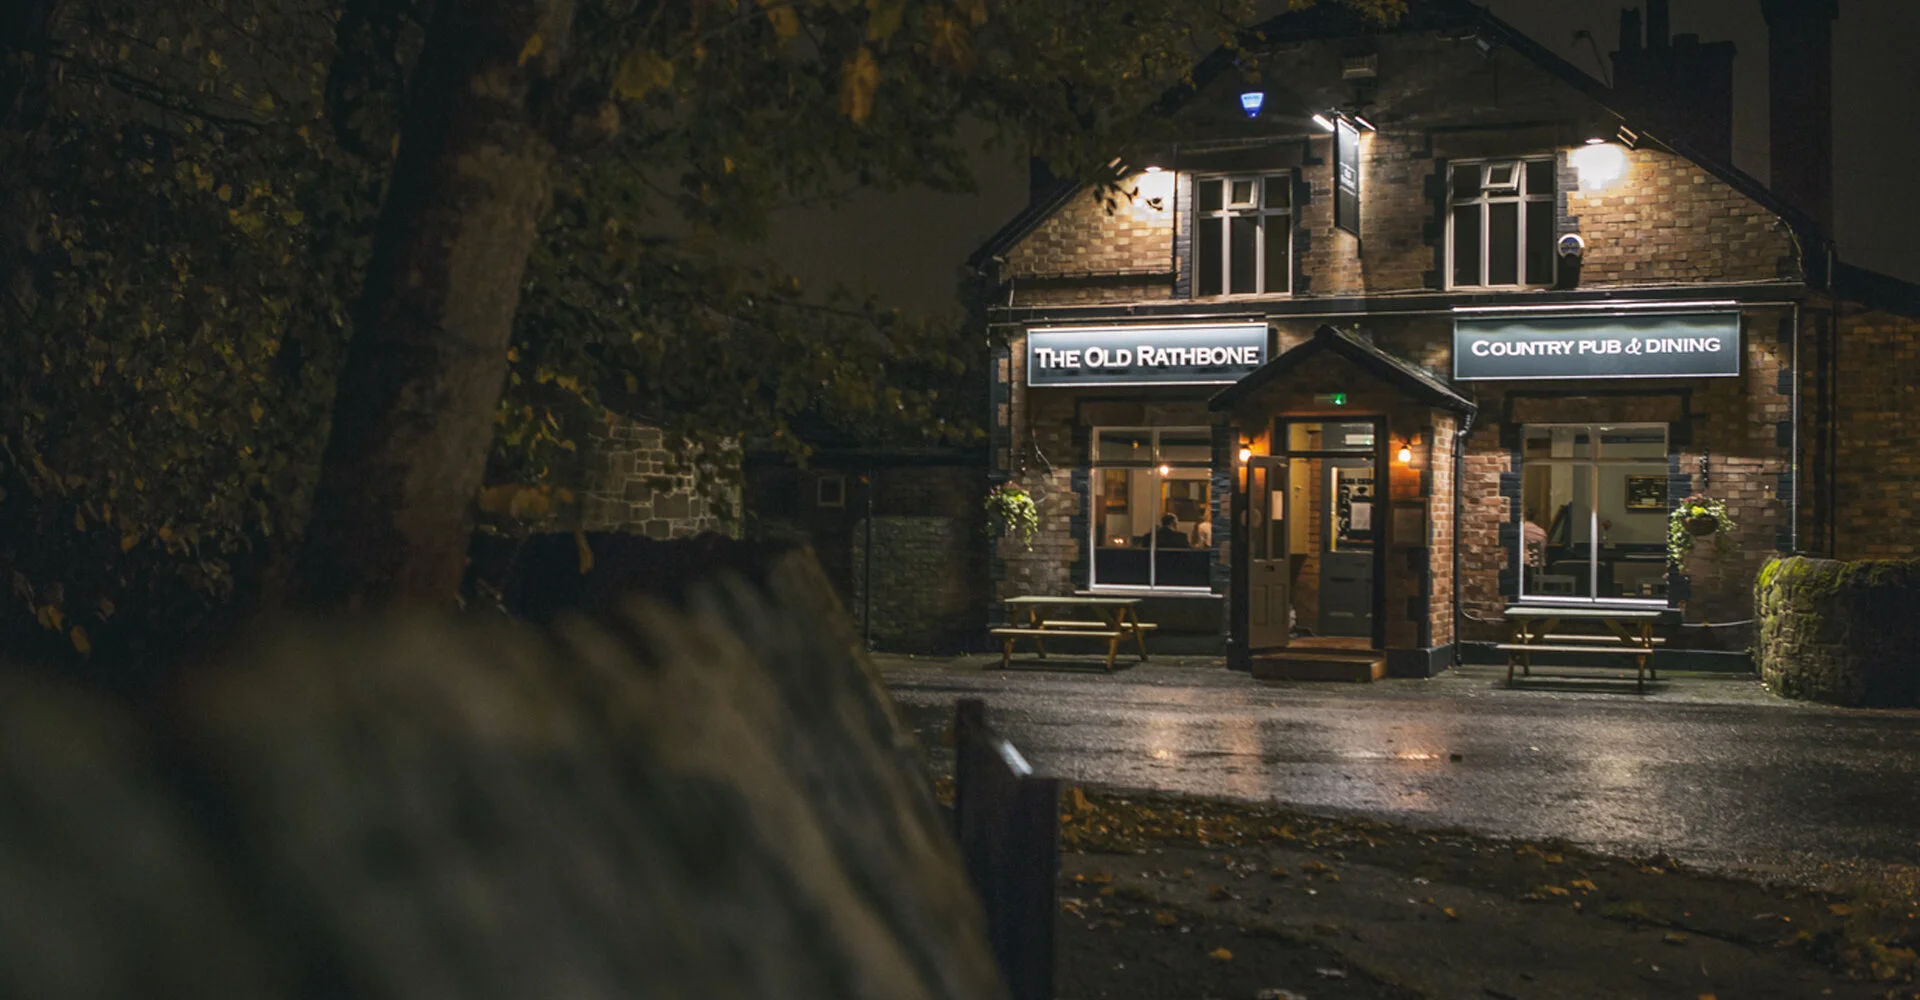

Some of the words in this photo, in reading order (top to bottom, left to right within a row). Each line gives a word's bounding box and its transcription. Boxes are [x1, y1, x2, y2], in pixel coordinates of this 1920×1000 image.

[1034, 347, 1081, 369] THE
[1084, 346, 1132, 368] OLD
[1136, 345, 1260, 367] RATHBONE
[1471, 339, 1575, 357] COUNTRY
[1578, 338, 1622, 355] PUB
[1624, 337, 1643, 355] &
[1645, 336, 1721, 354] DINING
